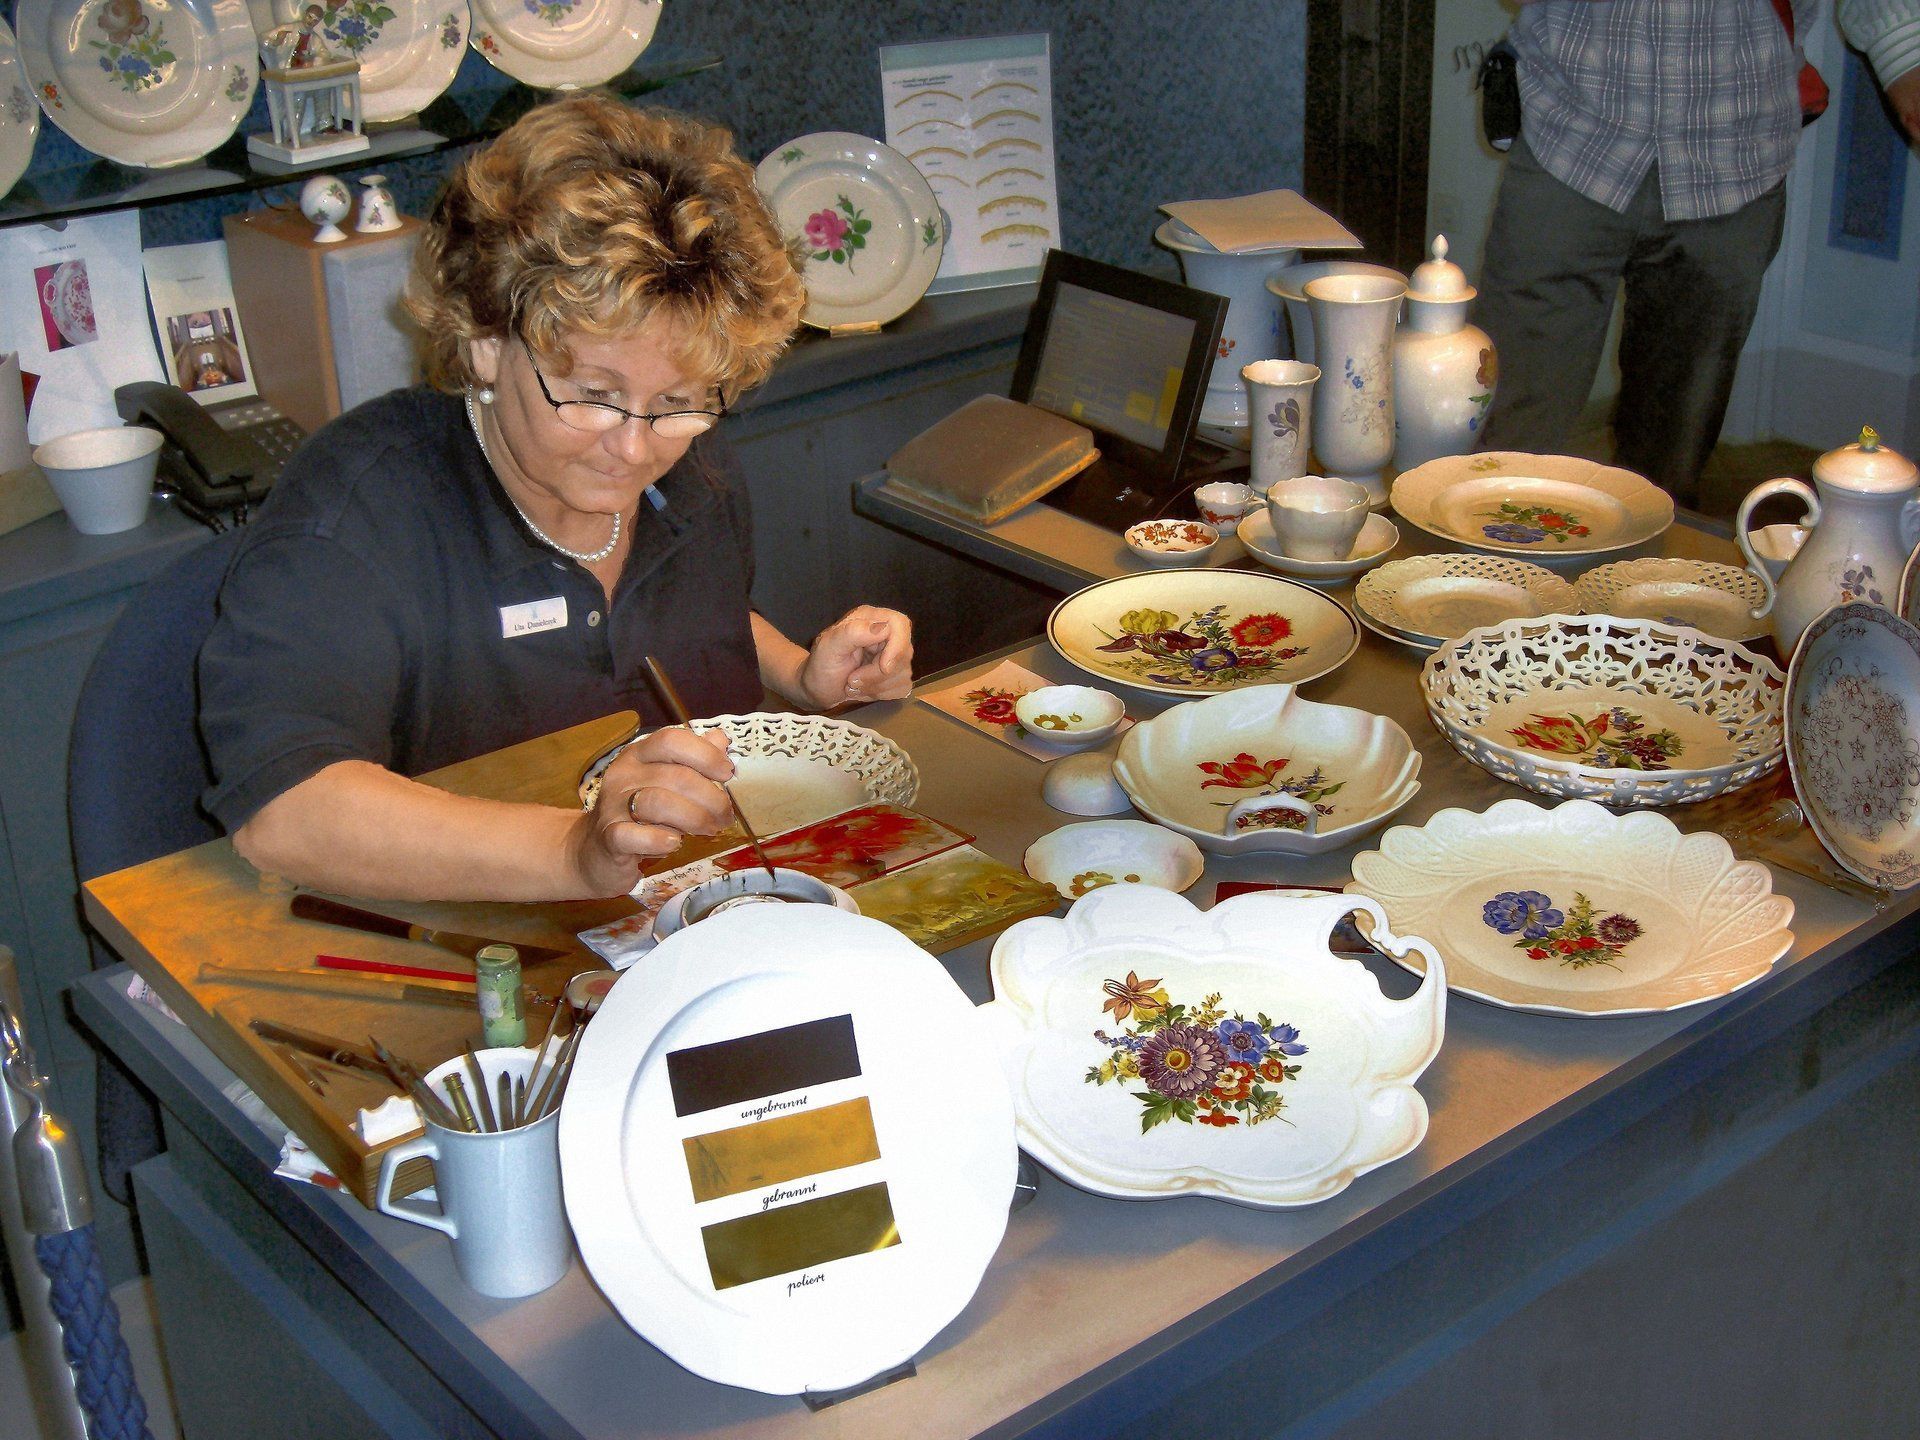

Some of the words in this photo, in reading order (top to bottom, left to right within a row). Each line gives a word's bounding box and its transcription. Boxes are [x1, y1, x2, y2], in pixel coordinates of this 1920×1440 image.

[741, 1095, 808, 1120] ungebrannt
[762, 1182, 817, 1210] gebrannt
[787, 1273, 825, 1297] poliert
